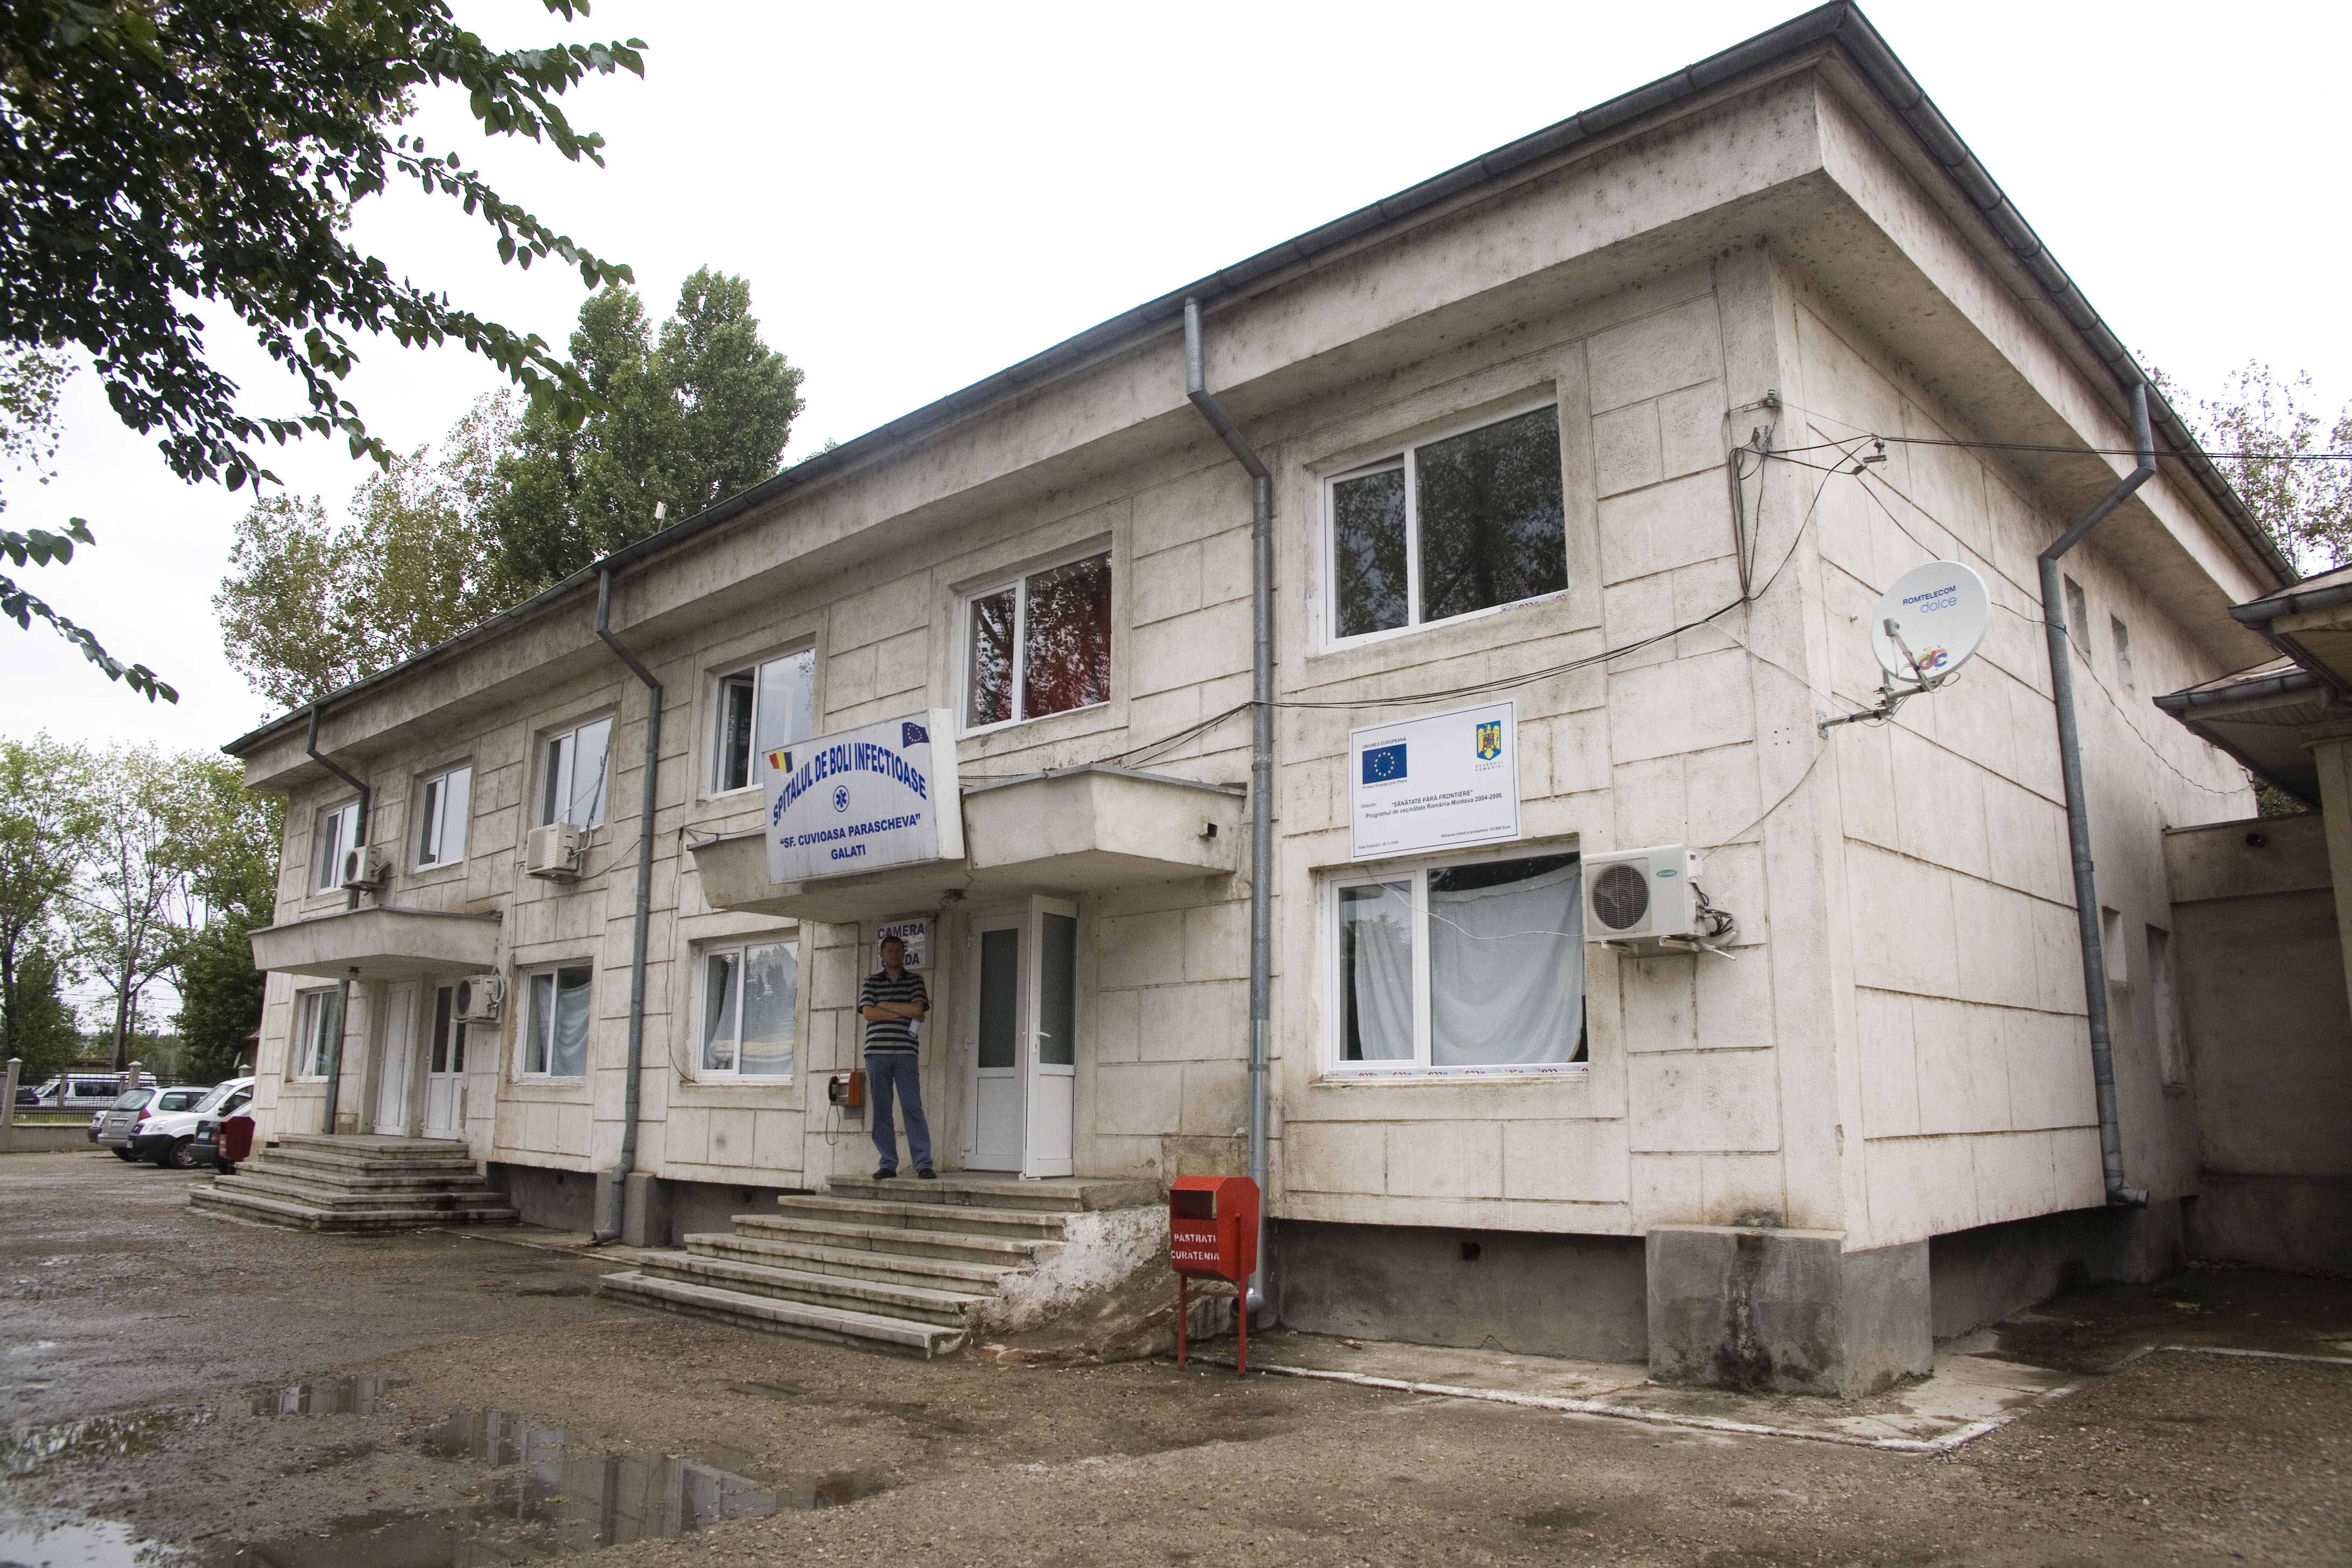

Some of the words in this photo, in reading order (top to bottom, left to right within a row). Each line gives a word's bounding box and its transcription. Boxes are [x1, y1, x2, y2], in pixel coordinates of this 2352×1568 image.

[1903, 585, 1956, 605] ROMTELECOM
[1920, 597, 1957, 613] dolce
[773, 761, 813, 827] SPITALUL
[815, 750, 828, 782] DE
[830, 743, 852, 775] BOLI
[855, 743, 927, 801] INFECTIOASE
[1366, 810, 1391, 818] Programul
[1475, 793, 1502, 802] 2004-2006
[798, 828, 846, 846] CUVIOASA
[831, 844, 866, 860] GALATI
[878, 923, 925, 940] CAMERA
